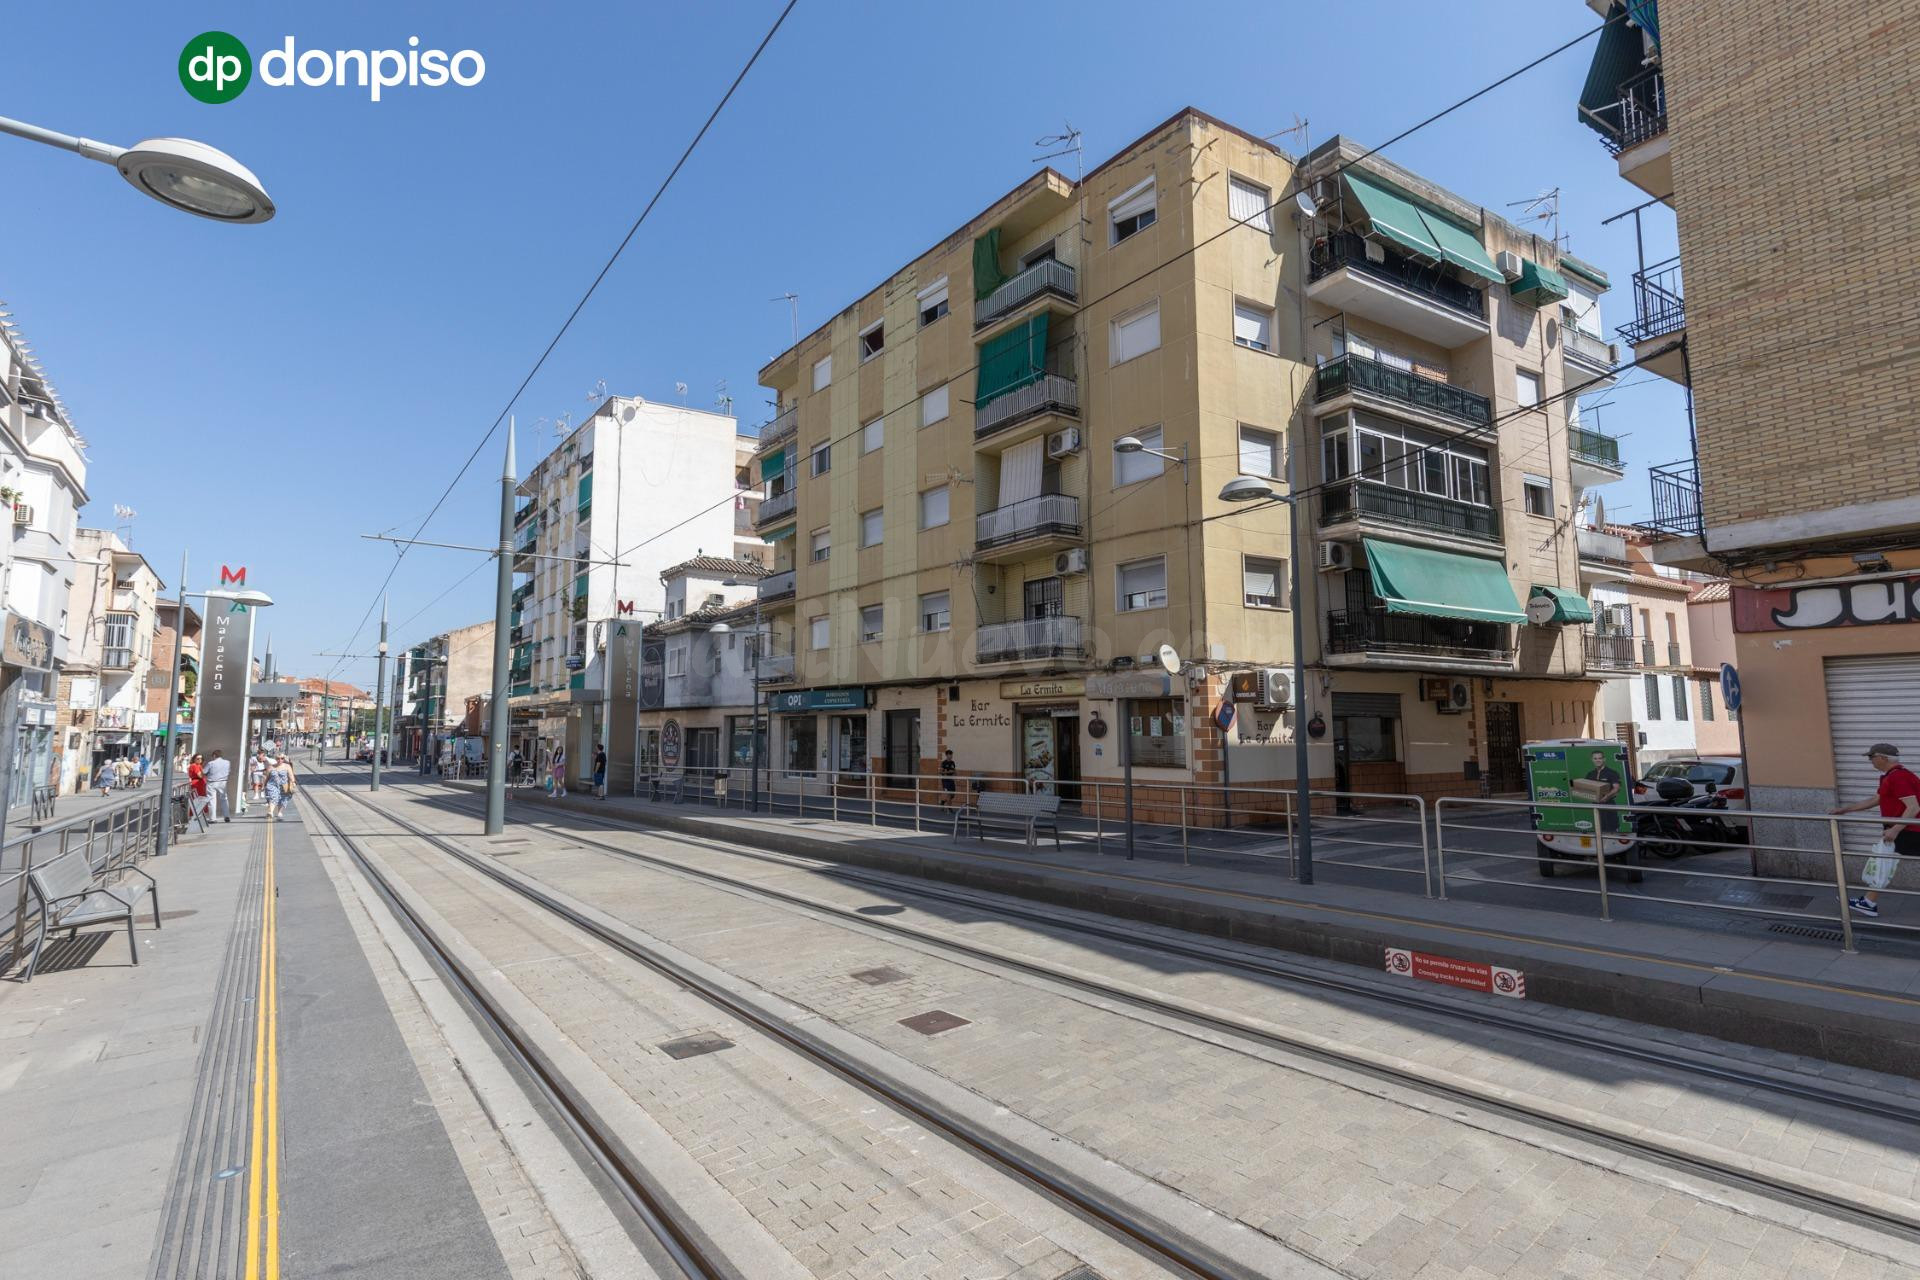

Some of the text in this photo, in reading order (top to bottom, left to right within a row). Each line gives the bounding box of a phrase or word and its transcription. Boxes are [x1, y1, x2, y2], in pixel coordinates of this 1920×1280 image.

[213, 616, 230, 690] Maracena
[625, 640, 634, 698] Maracena
[1020, 683, 1064, 695] La Ermita
[787, 695, 802, 706] OPI
[971, 699, 990, 711] Bar
[953, 713, 1011, 727] La Ermita
[1450, 963, 1467, 971] cruzar
